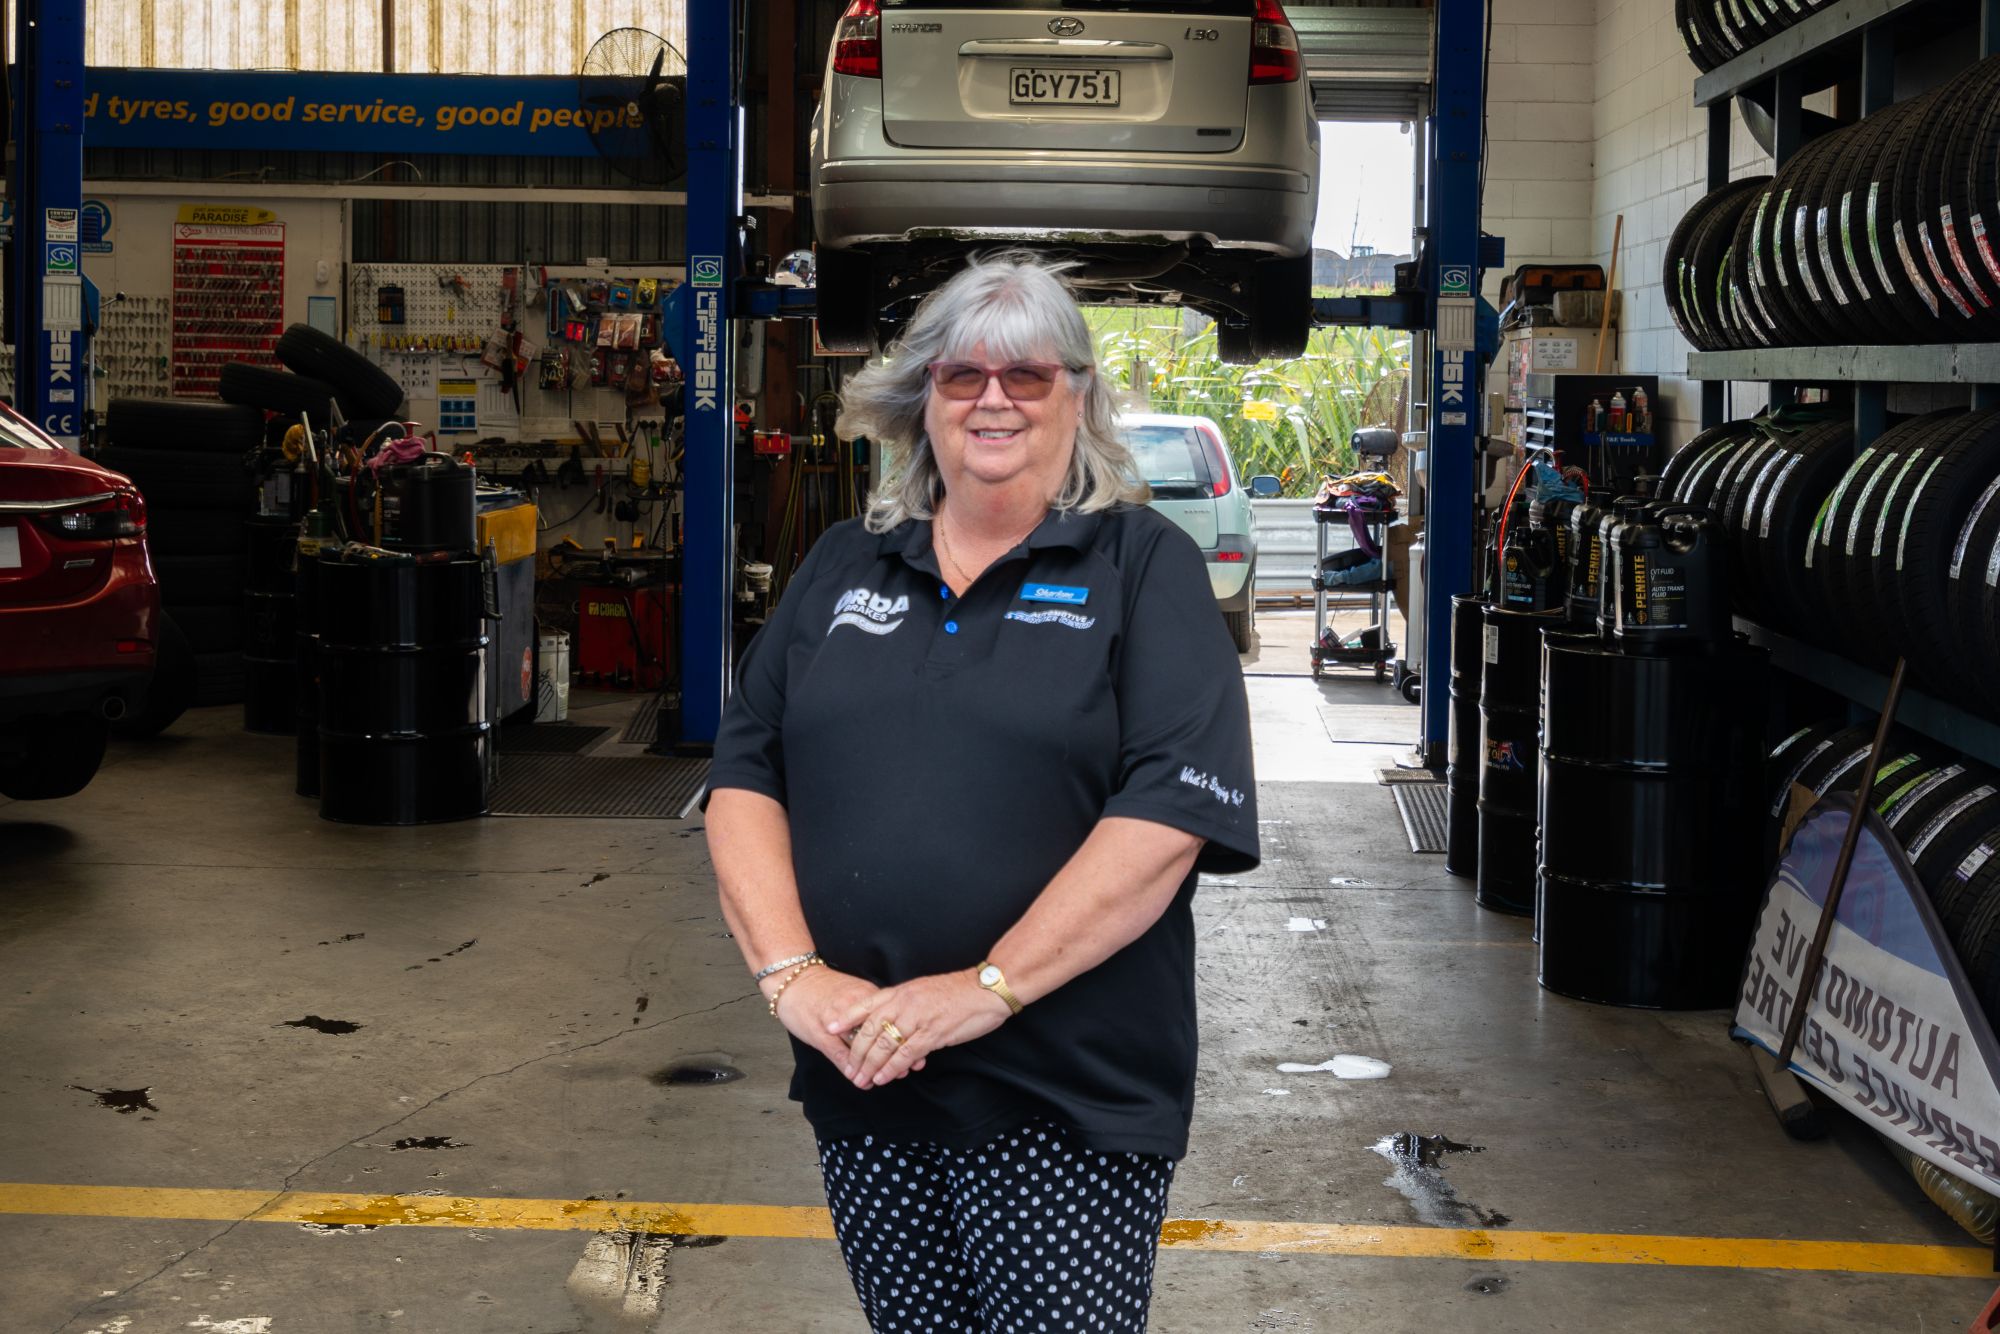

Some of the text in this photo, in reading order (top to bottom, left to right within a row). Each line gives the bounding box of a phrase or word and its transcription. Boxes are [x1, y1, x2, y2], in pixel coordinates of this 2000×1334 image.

[1015, 74, 1111, 100] GCY751
[107, 95, 198, 125] tyres,
[208, 96, 295, 127] good
[302, 98, 424, 127] service,
[435, 101, 524, 131] good
[530, 103, 644, 133] people
[192, 213, 248, 223] PARADISE
[708, 291, 717, 352] HESHBON
[1588, 534, 1601, 584] PENRITE
[1633, 554, 1648, 609] PENRITE
[843, 604, 888, 622] BRAKES
